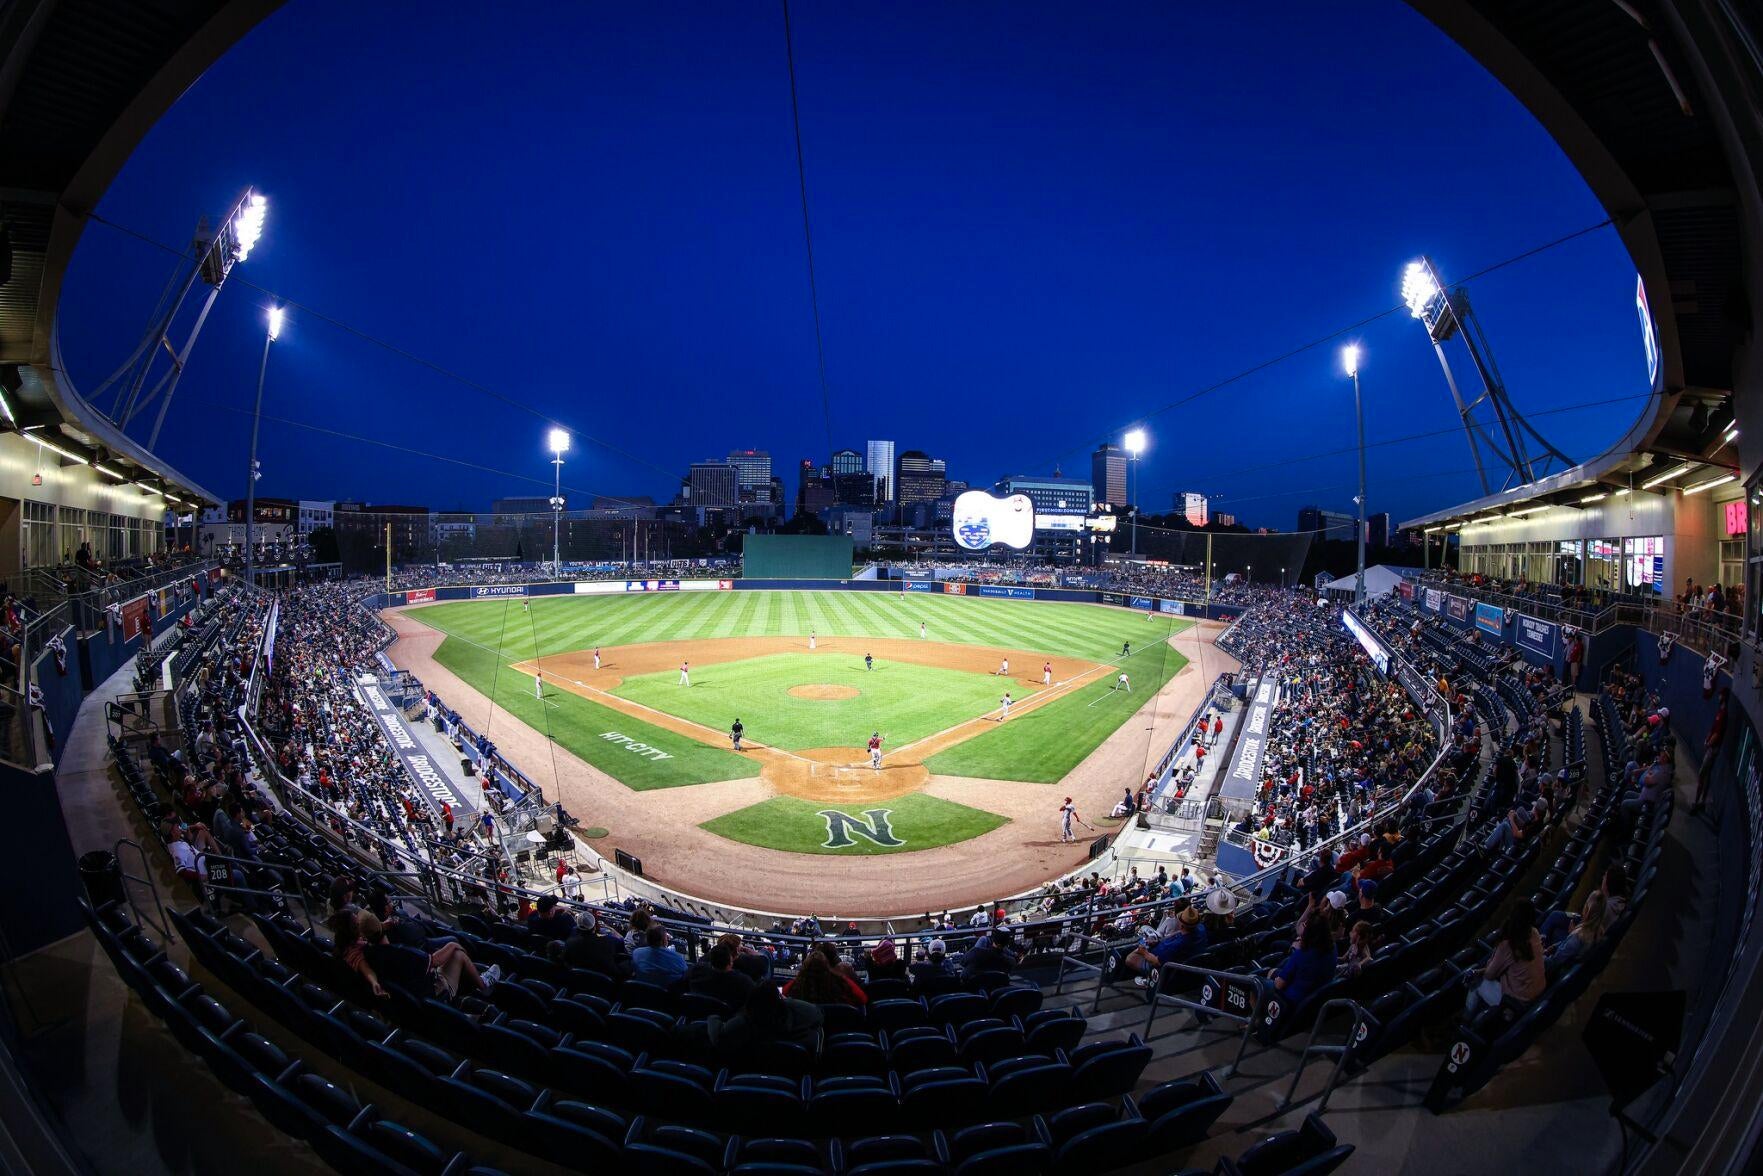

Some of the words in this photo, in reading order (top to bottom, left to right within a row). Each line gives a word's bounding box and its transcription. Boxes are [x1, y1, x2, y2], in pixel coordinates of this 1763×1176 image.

[491, 586, 524, 594] HYUNDAI
[598, 731, 635, 745] HIT
[625, 743, 675, 760] CITY
[406, 755, 462, 808] BRIDGESTONE
[815, 808, 908, 848] N
[211, 869, 227, 880] 208
[1228, 990, 1245, 1009] 208
[1229, 984, 1245, 996] SECTION
